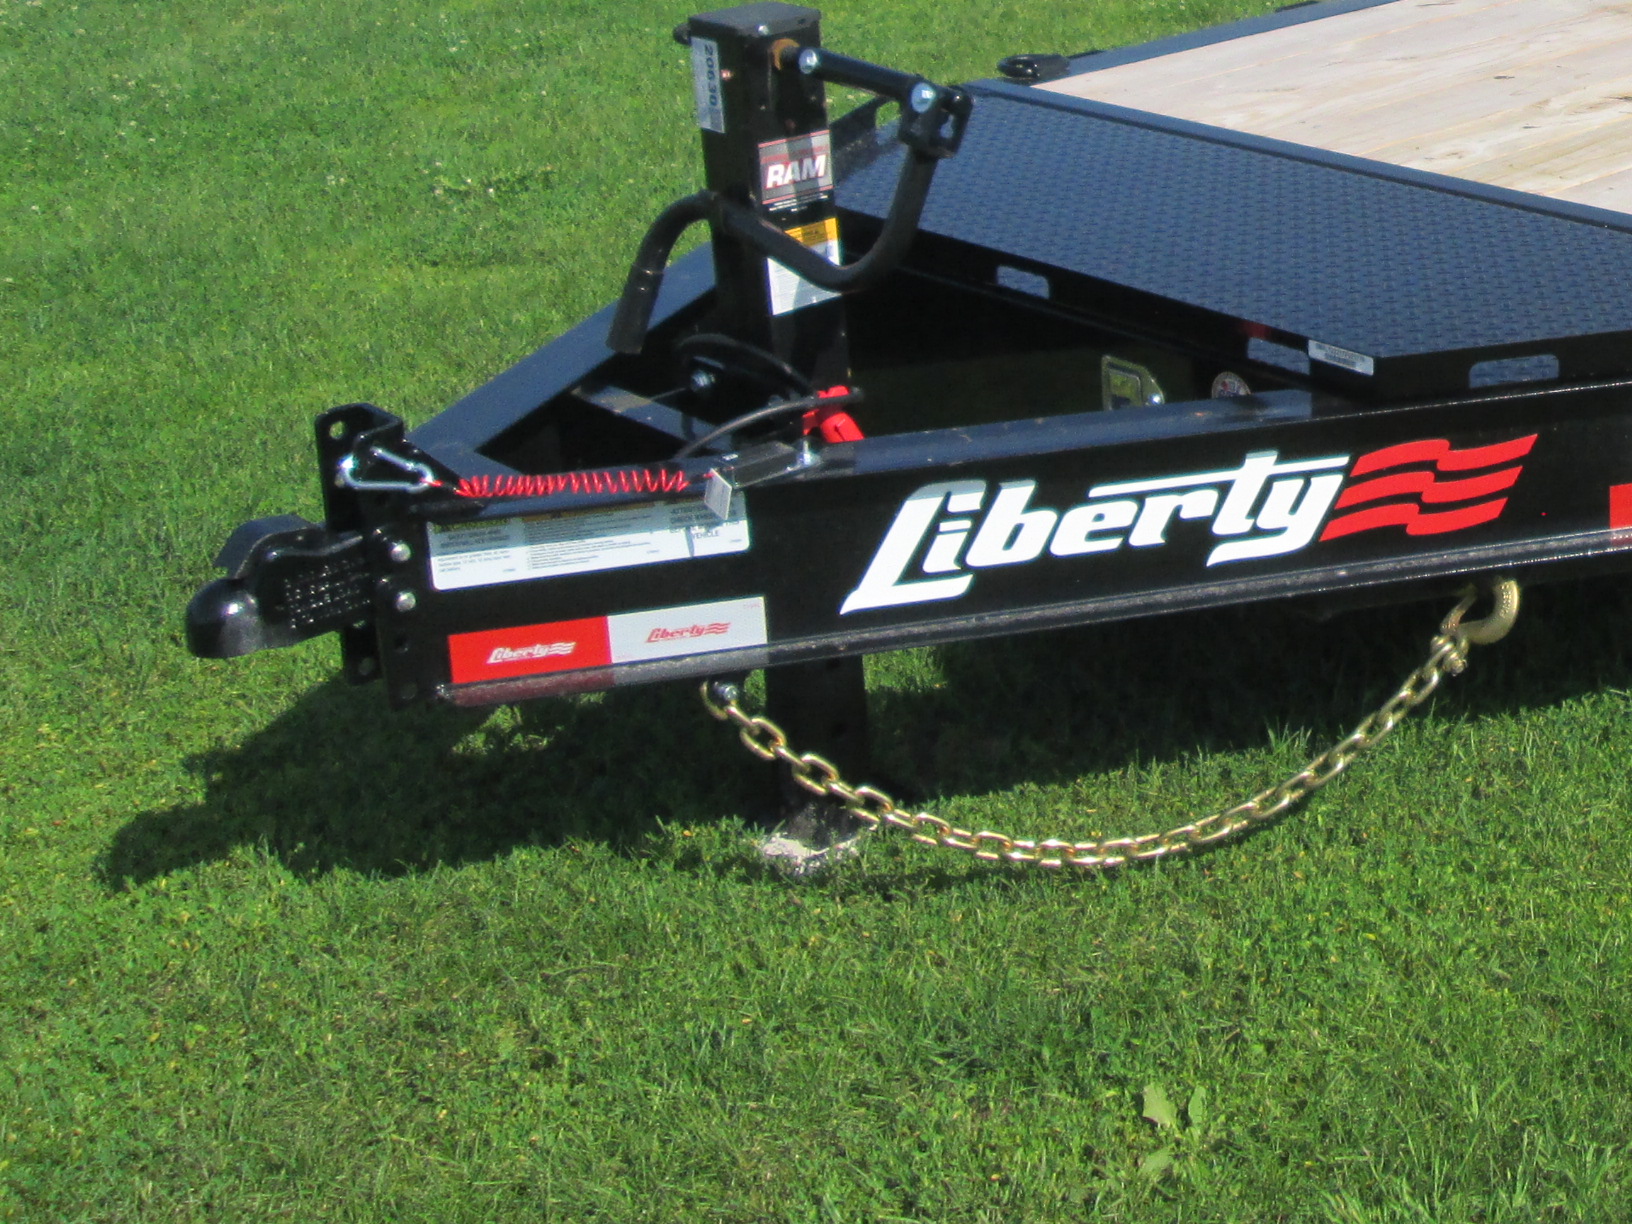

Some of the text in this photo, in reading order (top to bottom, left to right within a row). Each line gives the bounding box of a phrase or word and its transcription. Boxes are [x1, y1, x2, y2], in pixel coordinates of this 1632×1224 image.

[766, 154, 826, 189] RAM
[839, 450, 1350, 617] Liberty
[646, 625, 707, 644] Liberty
[486, 643, 551, 665] Liberty
